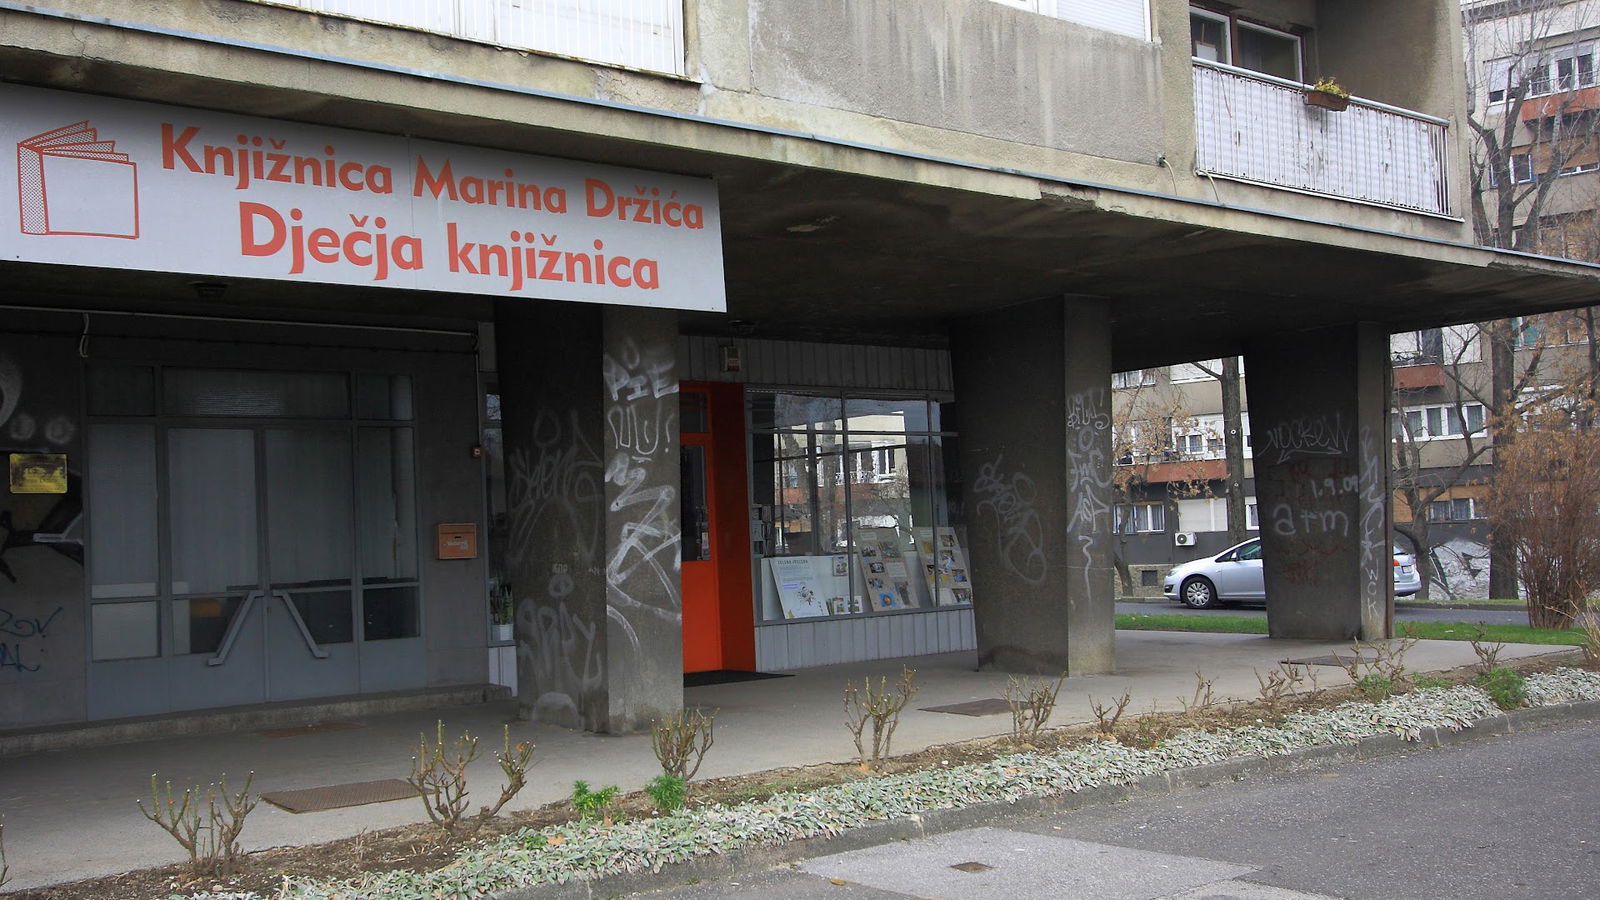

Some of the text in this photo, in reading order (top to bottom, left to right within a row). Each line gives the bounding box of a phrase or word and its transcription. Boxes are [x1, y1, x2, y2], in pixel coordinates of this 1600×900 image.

[161, 123, 704, 229] Knjižnica Marina Držića
[239, 201, 660, 291] Dječja knjižnica
